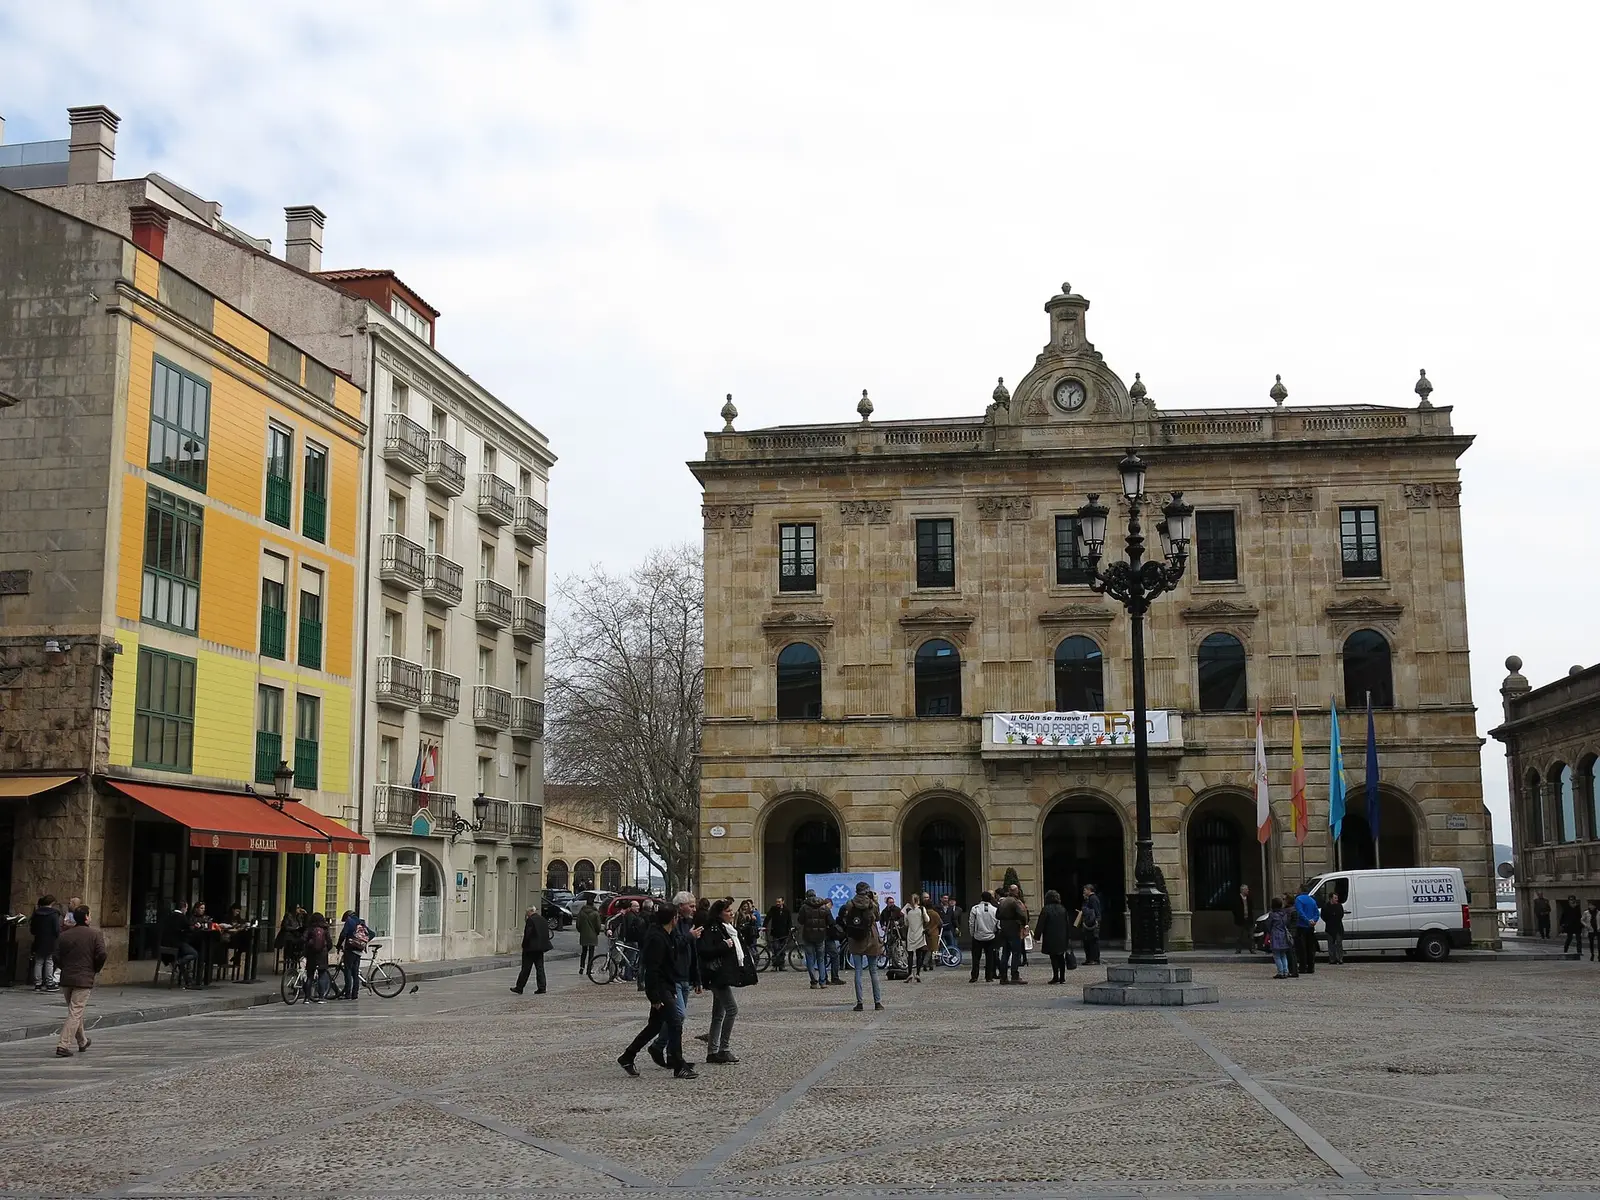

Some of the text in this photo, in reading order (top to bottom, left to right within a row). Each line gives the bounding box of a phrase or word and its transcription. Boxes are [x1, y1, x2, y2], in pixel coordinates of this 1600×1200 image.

[1018, 714, 1040, 722] Gijón
[1089, 712, 1155, 733] TRn
[1052, 723, 1090, 734] PERDER
[1092, 722, 1104, 733] EL
[1411, 884, 1453, 894] VILLAR
